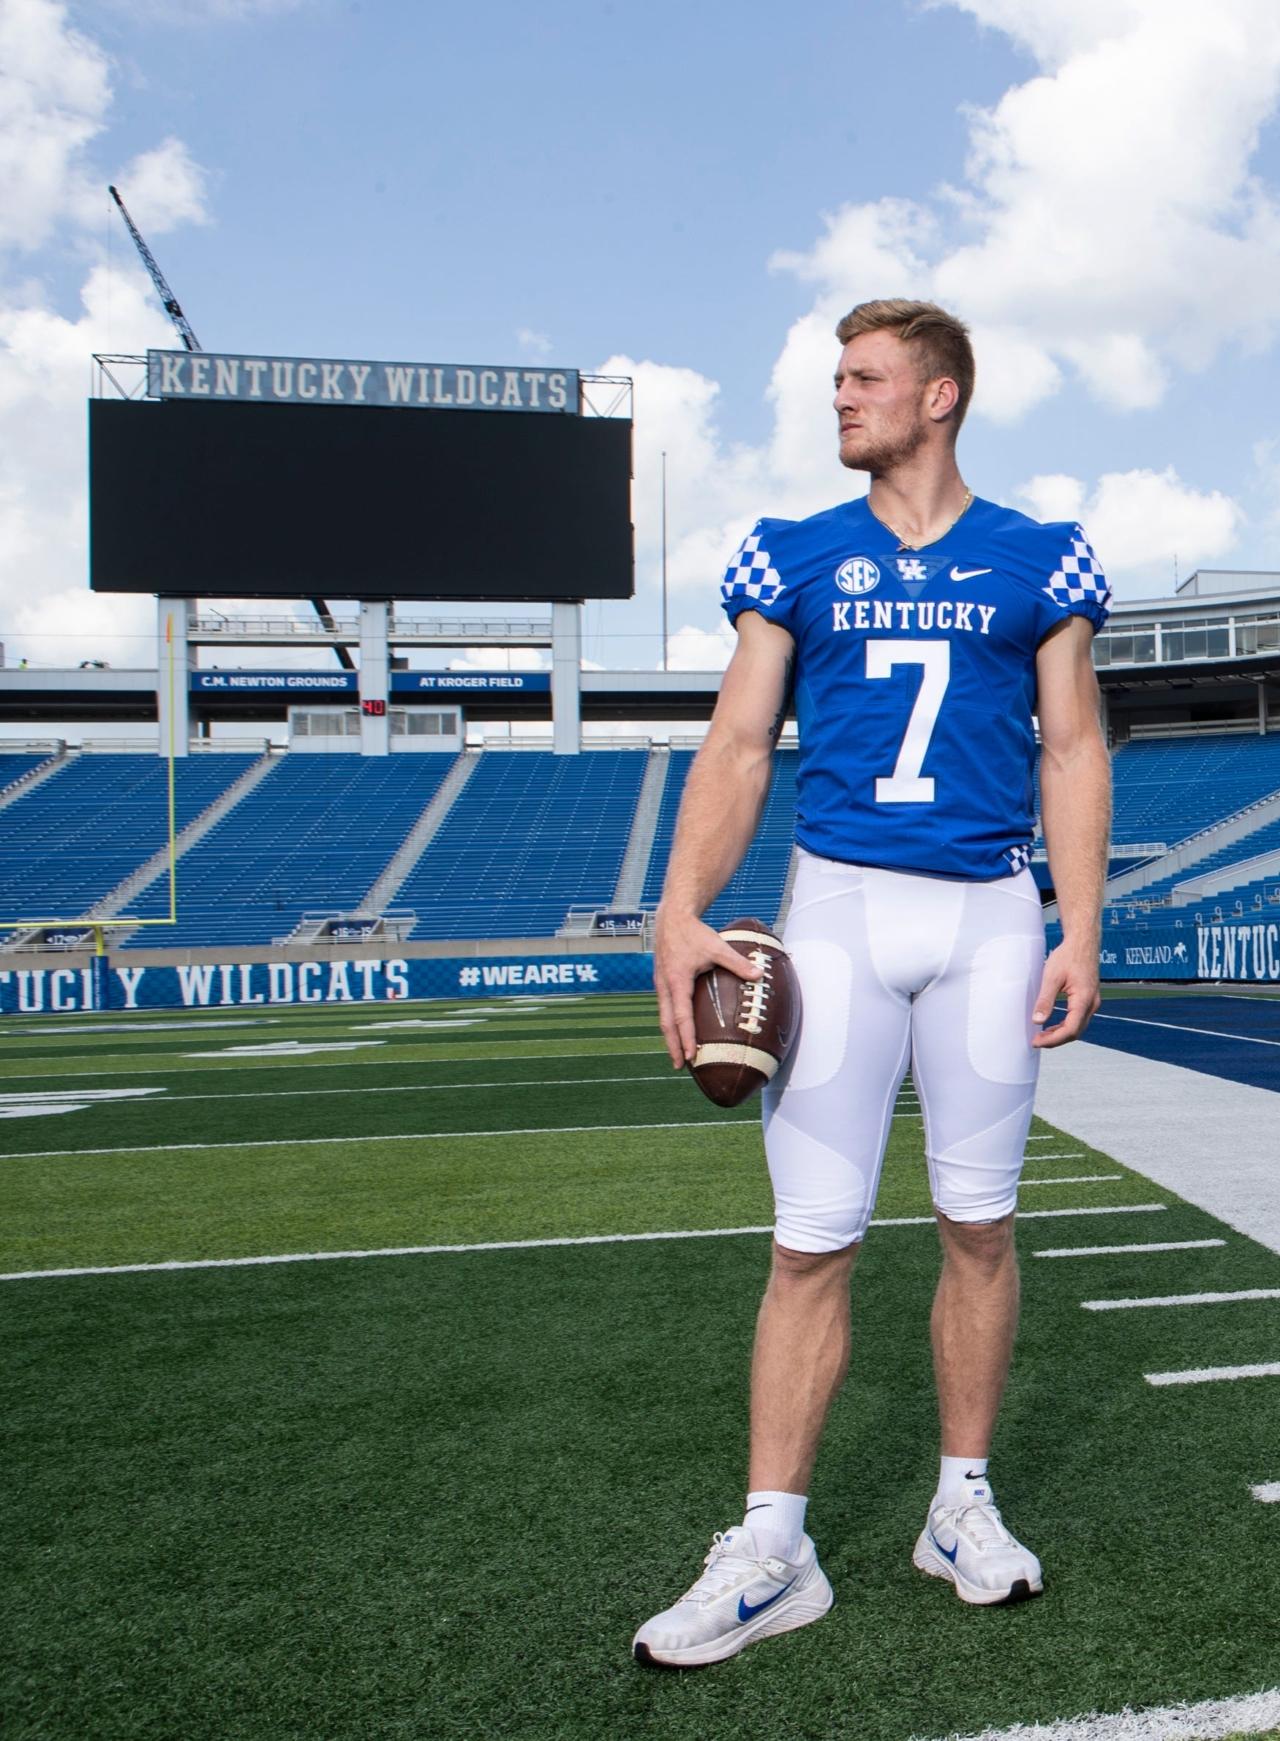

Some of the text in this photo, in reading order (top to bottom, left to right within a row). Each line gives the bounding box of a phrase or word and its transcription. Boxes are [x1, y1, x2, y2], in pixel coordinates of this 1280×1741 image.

[161, 355, 568, 408] KENTUCKY WILDCATS
[839, 561, 876, 592] SEC
[896, 558, 927, 581] UK
[832, 600, 996, 635] KENTUCKY
[201, 676, 348, 687] C.M. NEWTON GROUNDS
[419, 677, 524, 687] AT KROGER FIELD
[362, 700, 384, 716] 40
[865, 639, 951, 803] 7
[1125, 945, 1171, 965] KEENELAND
[176, 959, 409, 1006] WILDCATS
